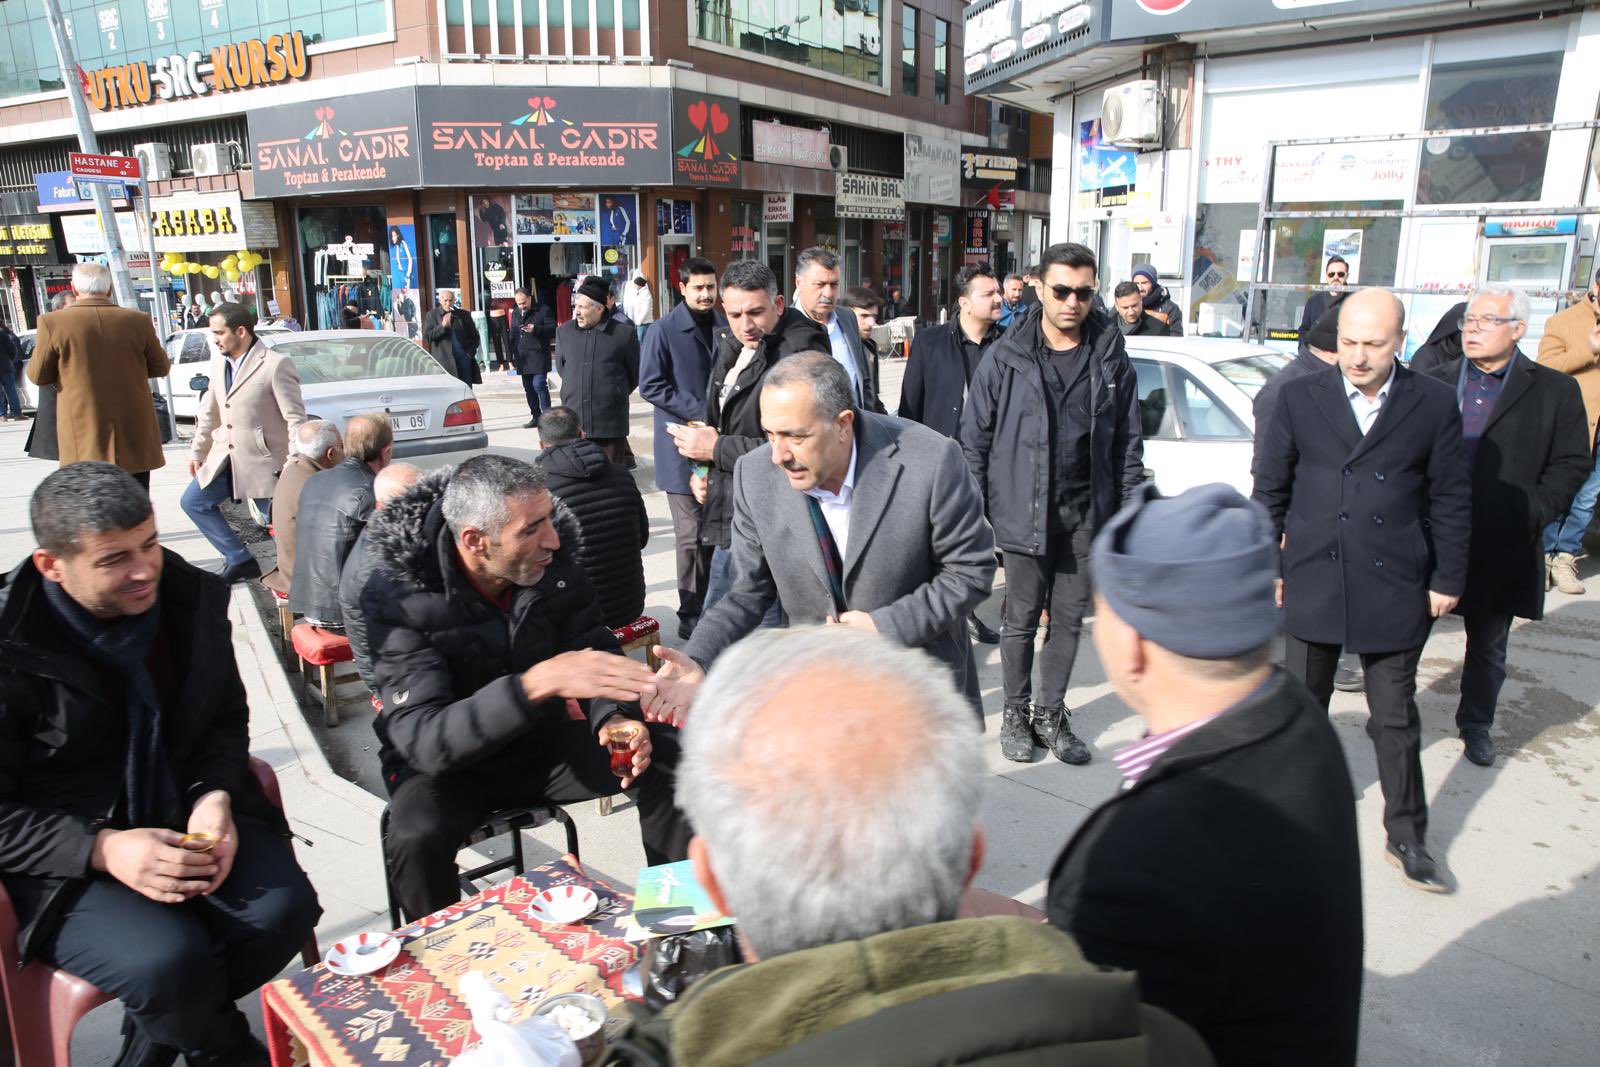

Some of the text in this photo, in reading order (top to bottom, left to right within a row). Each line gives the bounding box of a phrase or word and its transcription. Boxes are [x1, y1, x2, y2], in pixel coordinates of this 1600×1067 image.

[98, 8, 119, 29] SRC
[211, 9, 219, 29] 4
[156, 22, 165, 41] 3
[108, 33, 117, 50] 2
[88, 30, 306, 109] UTKU SRC KURSU
[432, 128, 544, 150] SANAL
[74, 157, 119, 168] HASTANE
[258, 142, 329, 171] SANAL
[474, 151, 625, 170] Toptan & Perakende
[1215, 157, 1243, 166] THY
[283, 162, 386, 189] Toptan & Perakende
[677, 161, 708, 172] SANAL
[881, 182, 901, 198] BAL
[968, 210, 988, 218] UTKU
[392, 415, 423, 429] N 09
